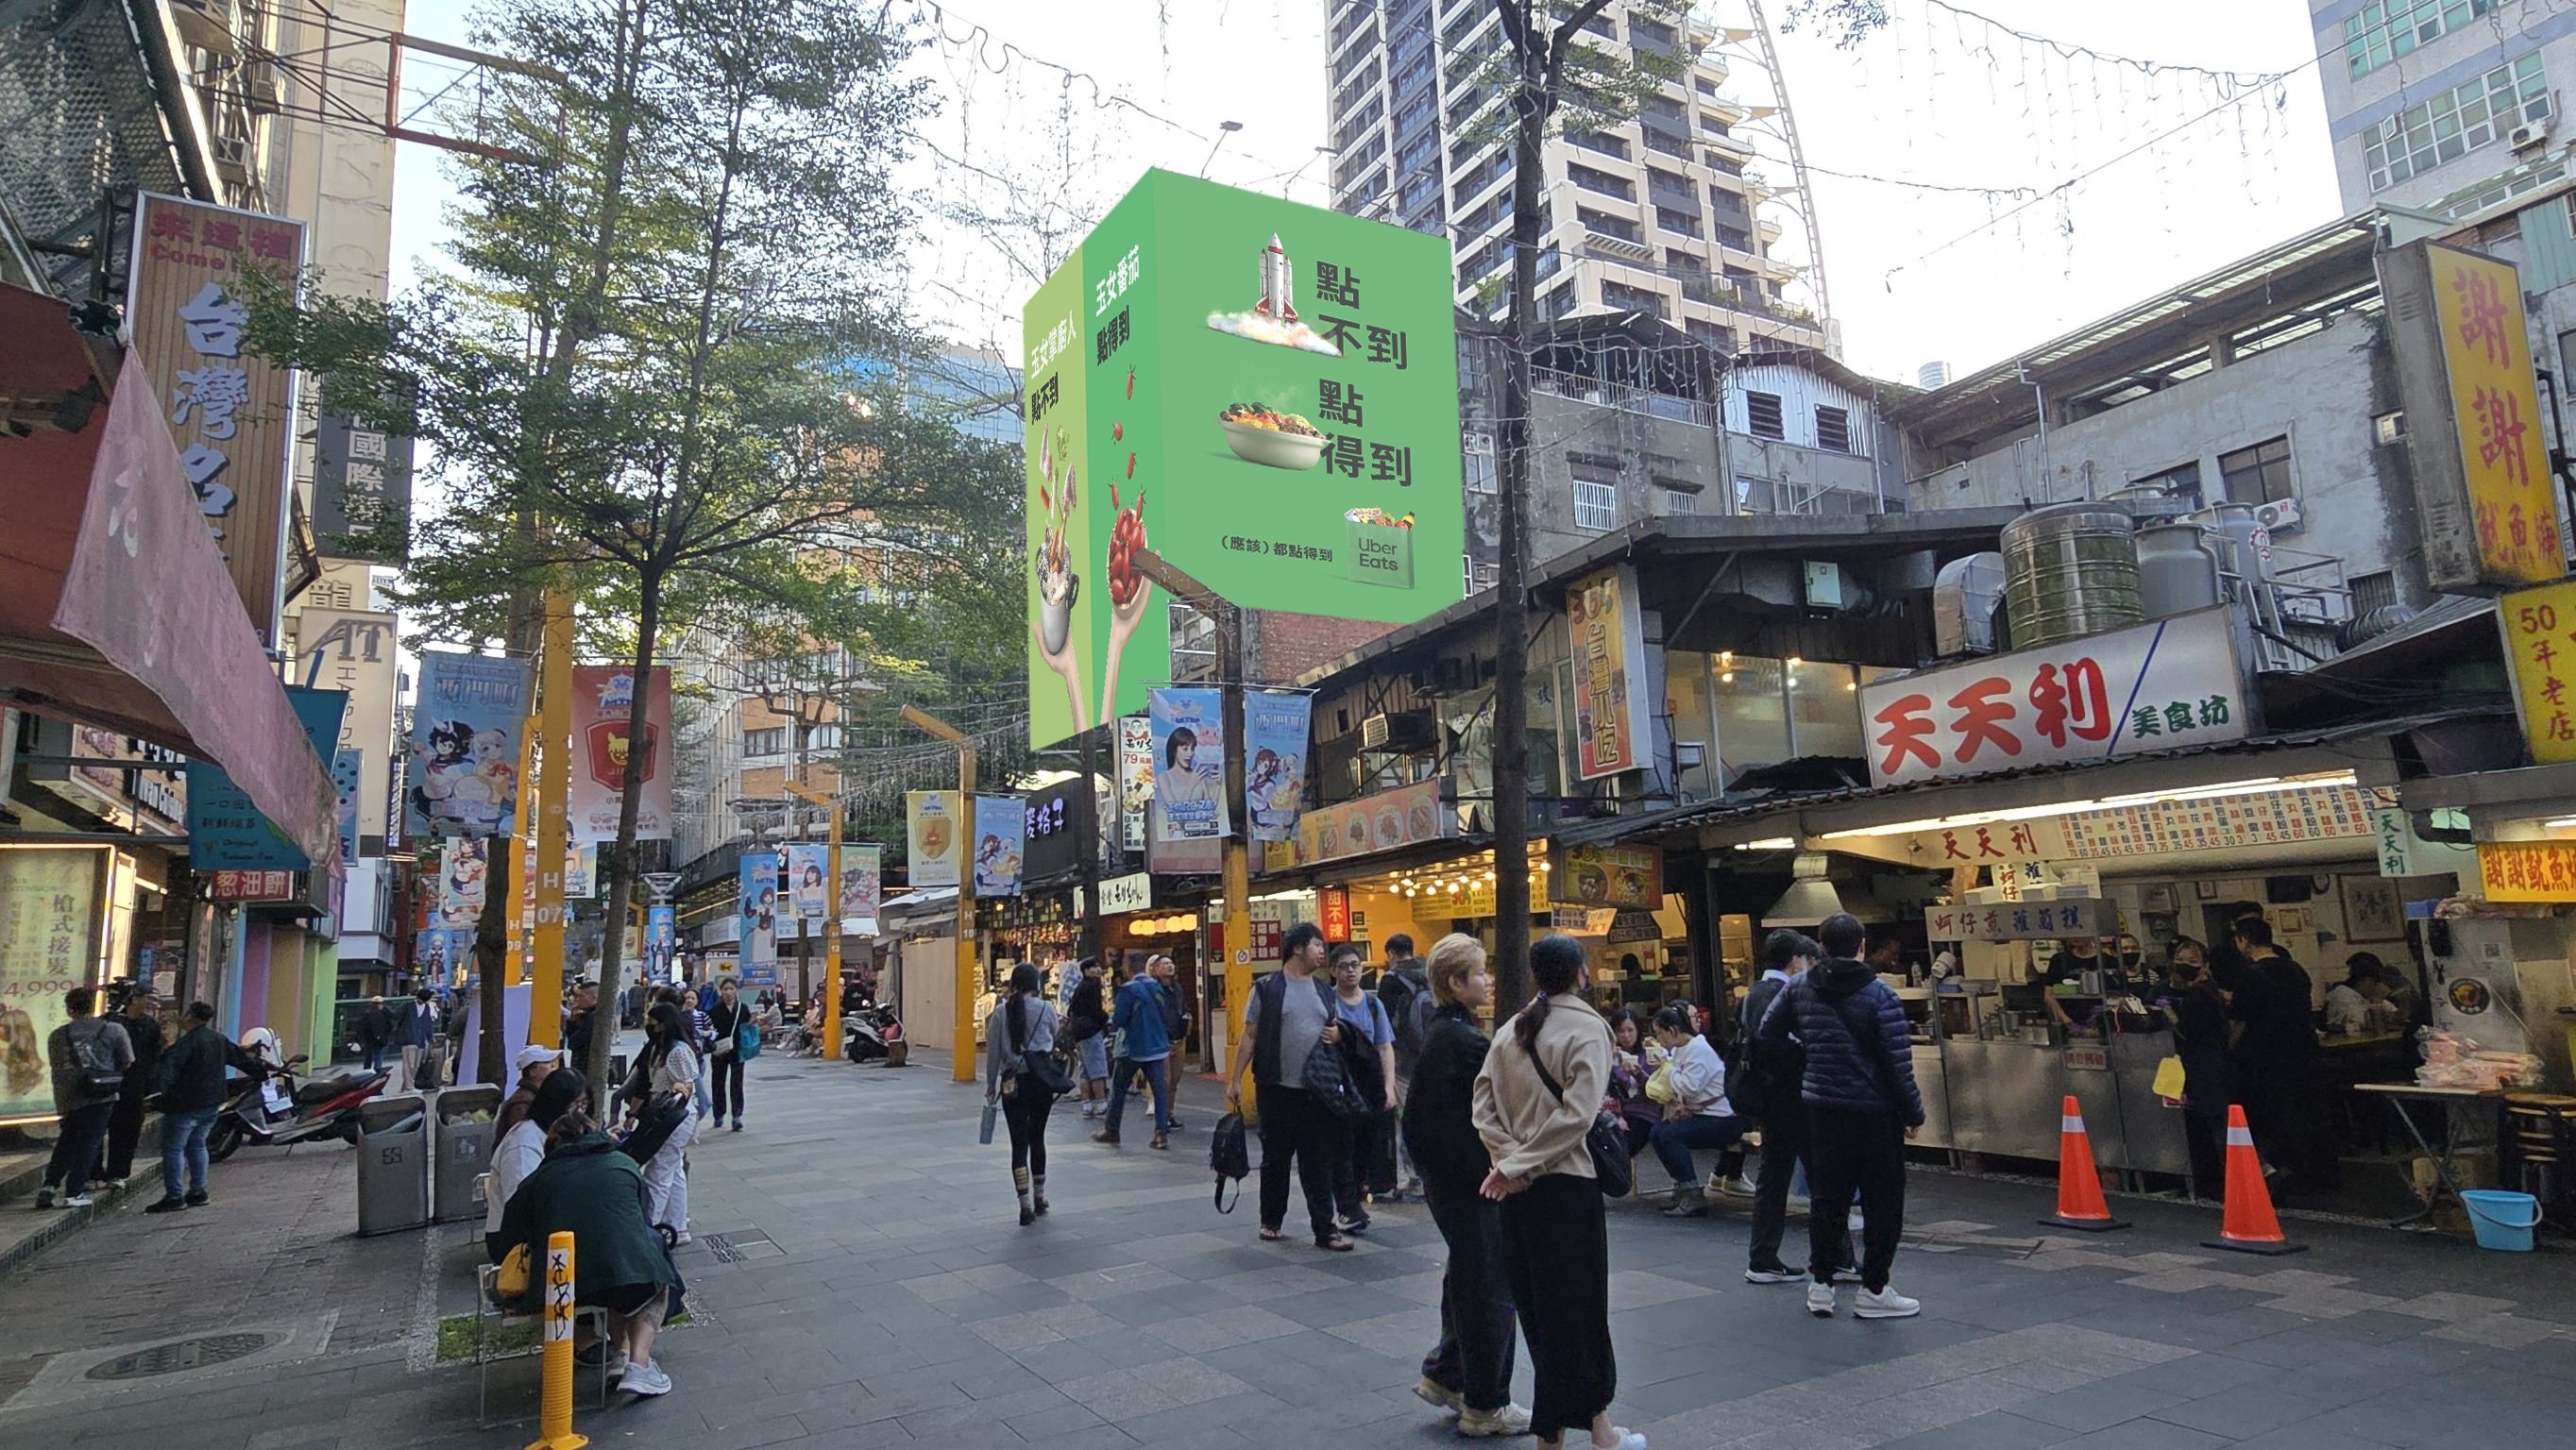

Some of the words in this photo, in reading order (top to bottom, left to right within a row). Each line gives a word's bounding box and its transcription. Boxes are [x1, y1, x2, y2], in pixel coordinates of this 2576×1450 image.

[151, 243, 226, 270] Come
[1095, 244, 1141, 317] 玉女番茄
[1316, 261, 1360, 310] 點
[1031, 310, 1076, 379] 玉女掌廚人
[1096, 304, 1130, 366] 點得到
[1319, 314, 1408, 370] 不到
[1031, 372, 1059, 425] 點不到
[1319, 379, 1364, 428] 點
[1320, 432, 1412, 487] 得到
[1358, 536, 1398, 554] Uber
[1359, 553, 1398, 572] Eats
[1873, 657, 2111, 776] 天天利
[2131, 694, 2229, 739] 美食坊
[1942, 822, 2039, 860] 天天利
[2381, 814, 2405, 874] 天天利
[543, 872, 559, 888] H
[509, 919, 519, 930] H
[537, 906, 563, 923] 07
[963, 929, 974, 938] 10
[964, 911, 974, 920] H
[1327, 890, 1345, 939] 甜不辣
[1935, 910, 2003, 936] 蚵仔煎
[4, 979, 74, 998] 4,999
